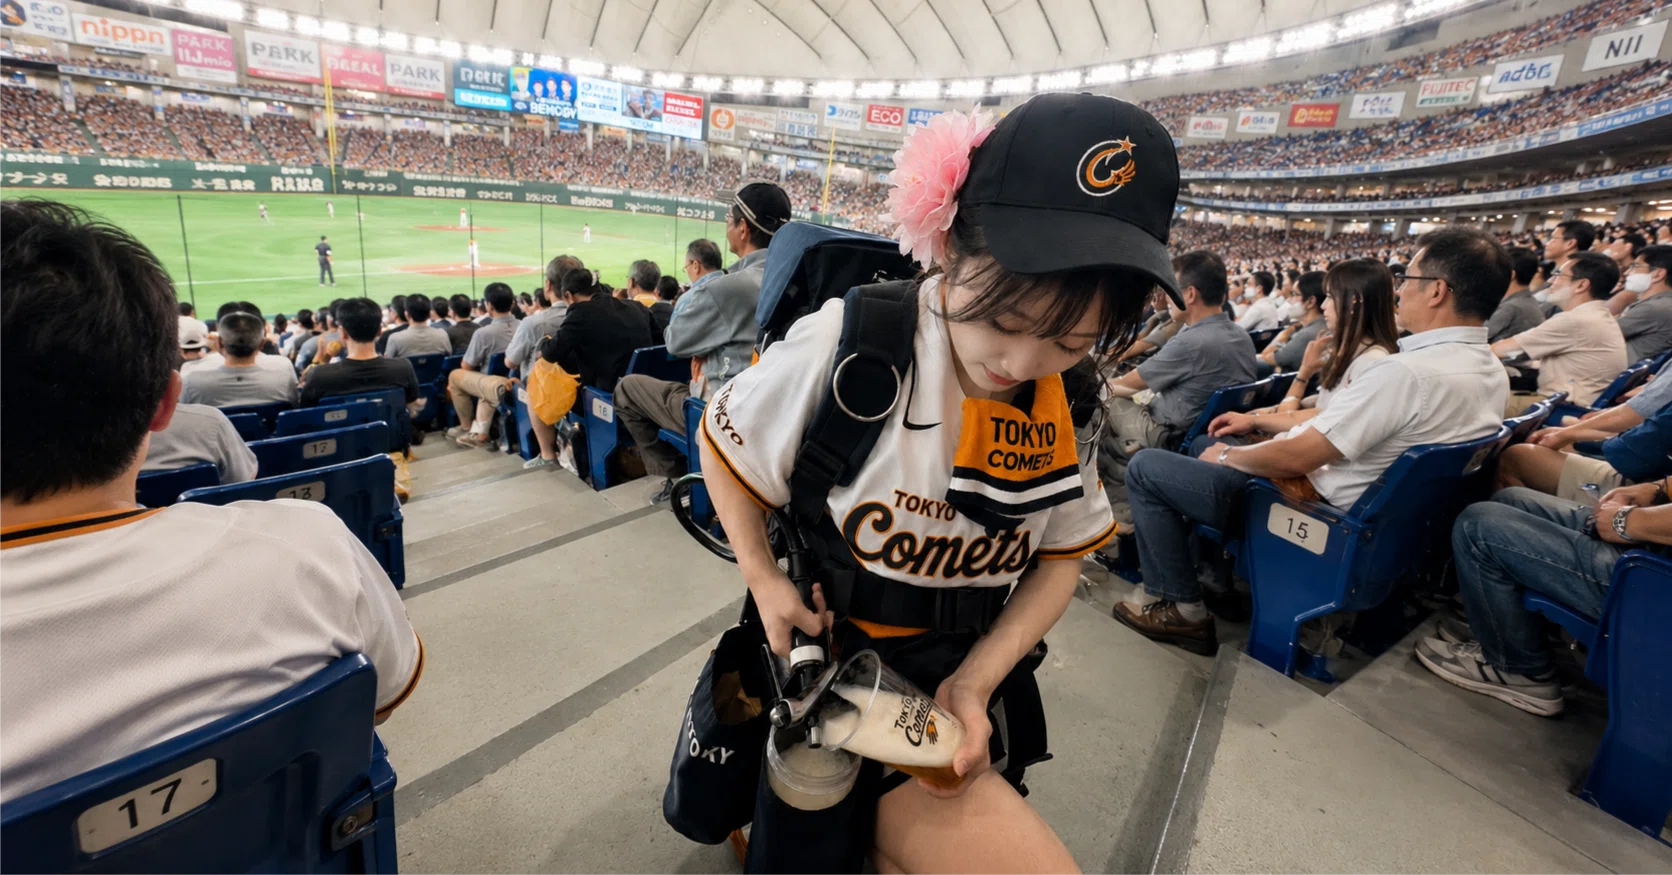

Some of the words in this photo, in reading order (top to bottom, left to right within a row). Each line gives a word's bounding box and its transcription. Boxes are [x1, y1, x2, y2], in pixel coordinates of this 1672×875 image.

[81, 18, 165, 45] nippn
[177, 33, 228, 52] PARK
[251, 41, 314, 64] PARK
[389, 62, 441, 82] PARK
[871, 109, 901, 124] ECO
[990, 416, 1056, 448] TOKYO
[987, 449, 1055, 471] COMETS
[894, 489, 956, 521] TOKYO
[842, 501, 1031, 579] Comets
[1287, 517, 1309, 540] 15
[117, 777, 182, 829] 17
